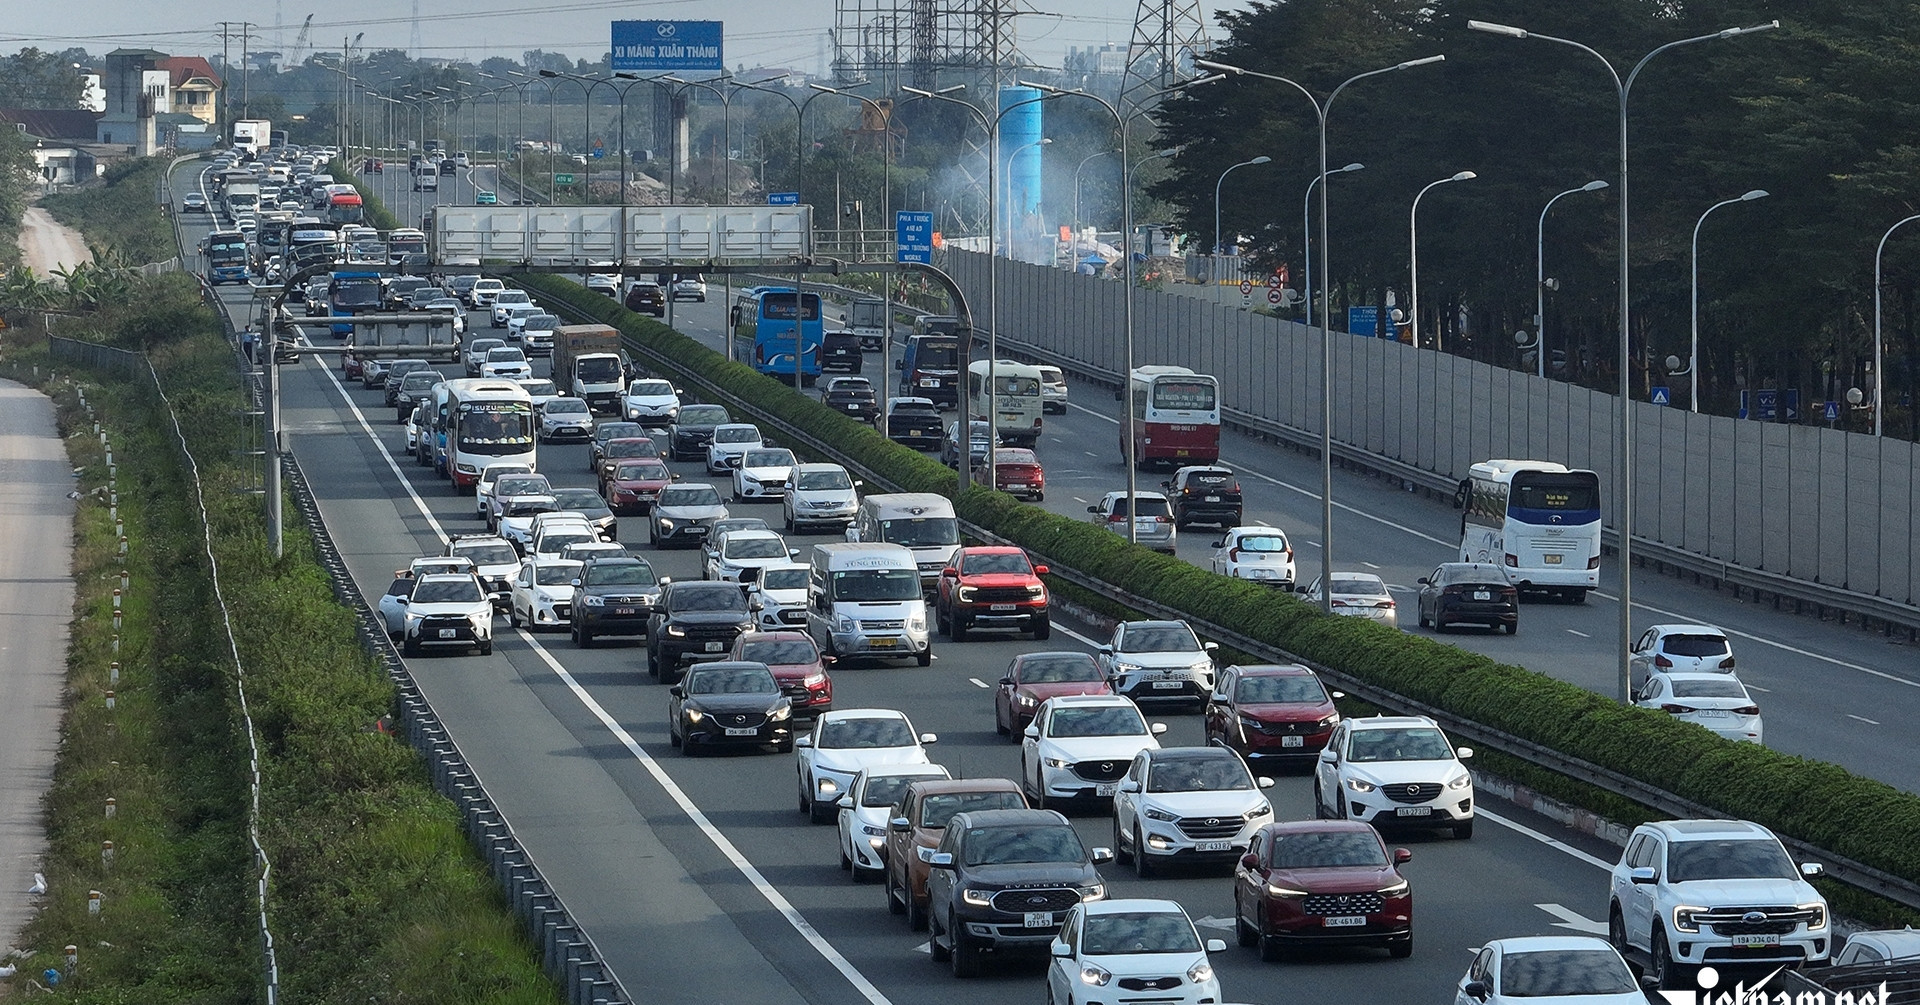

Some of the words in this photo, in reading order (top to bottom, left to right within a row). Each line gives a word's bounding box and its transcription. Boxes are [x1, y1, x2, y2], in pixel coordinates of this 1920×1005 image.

[614, 46, 624, 58] XI
[627, 44, 656, 58] MĂNG
[658, 43, 684, 58] XUÂN
[686, 43, 718, 58] THÀNH
